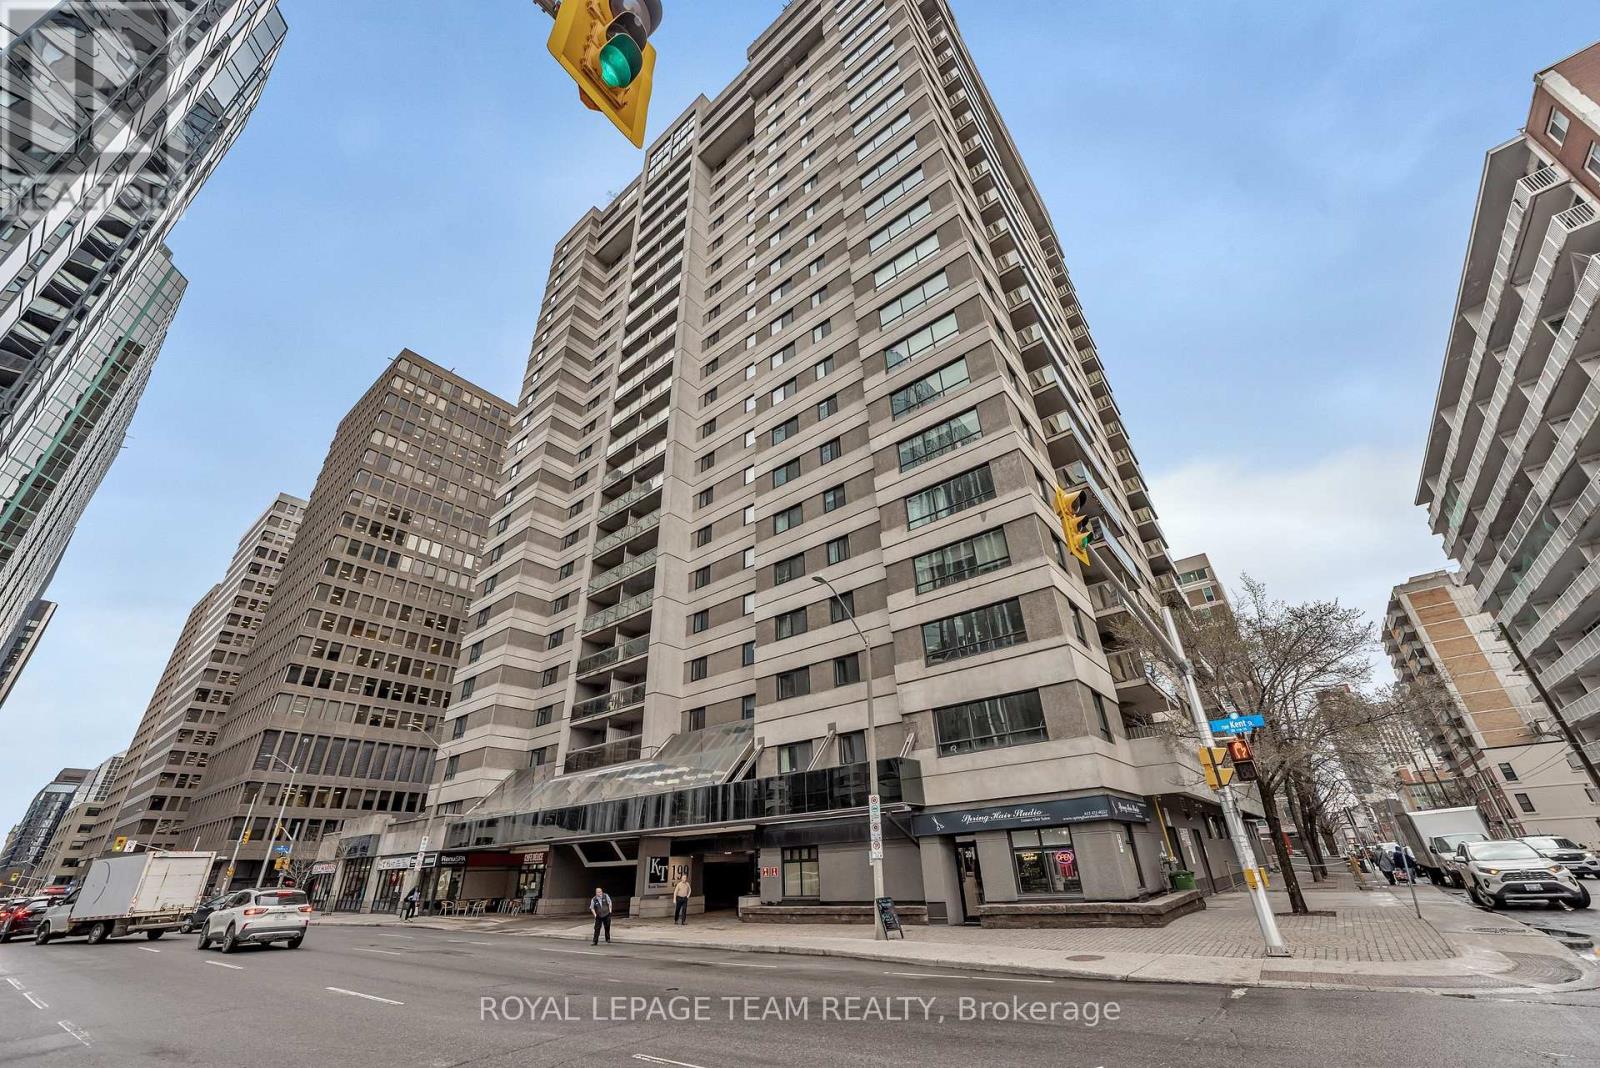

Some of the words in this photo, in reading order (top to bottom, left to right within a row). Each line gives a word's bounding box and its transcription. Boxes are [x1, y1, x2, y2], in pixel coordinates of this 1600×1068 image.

[1230, 720, 1247, 728] Kent
[962, 814, 989, 825] Spring
[991, 811, 1011, 819] Hair
[1013, 808, 1042, 817] Studio
[1056, 853, 1071, 861] OPEN
[672, 865, 689, 880] 199
